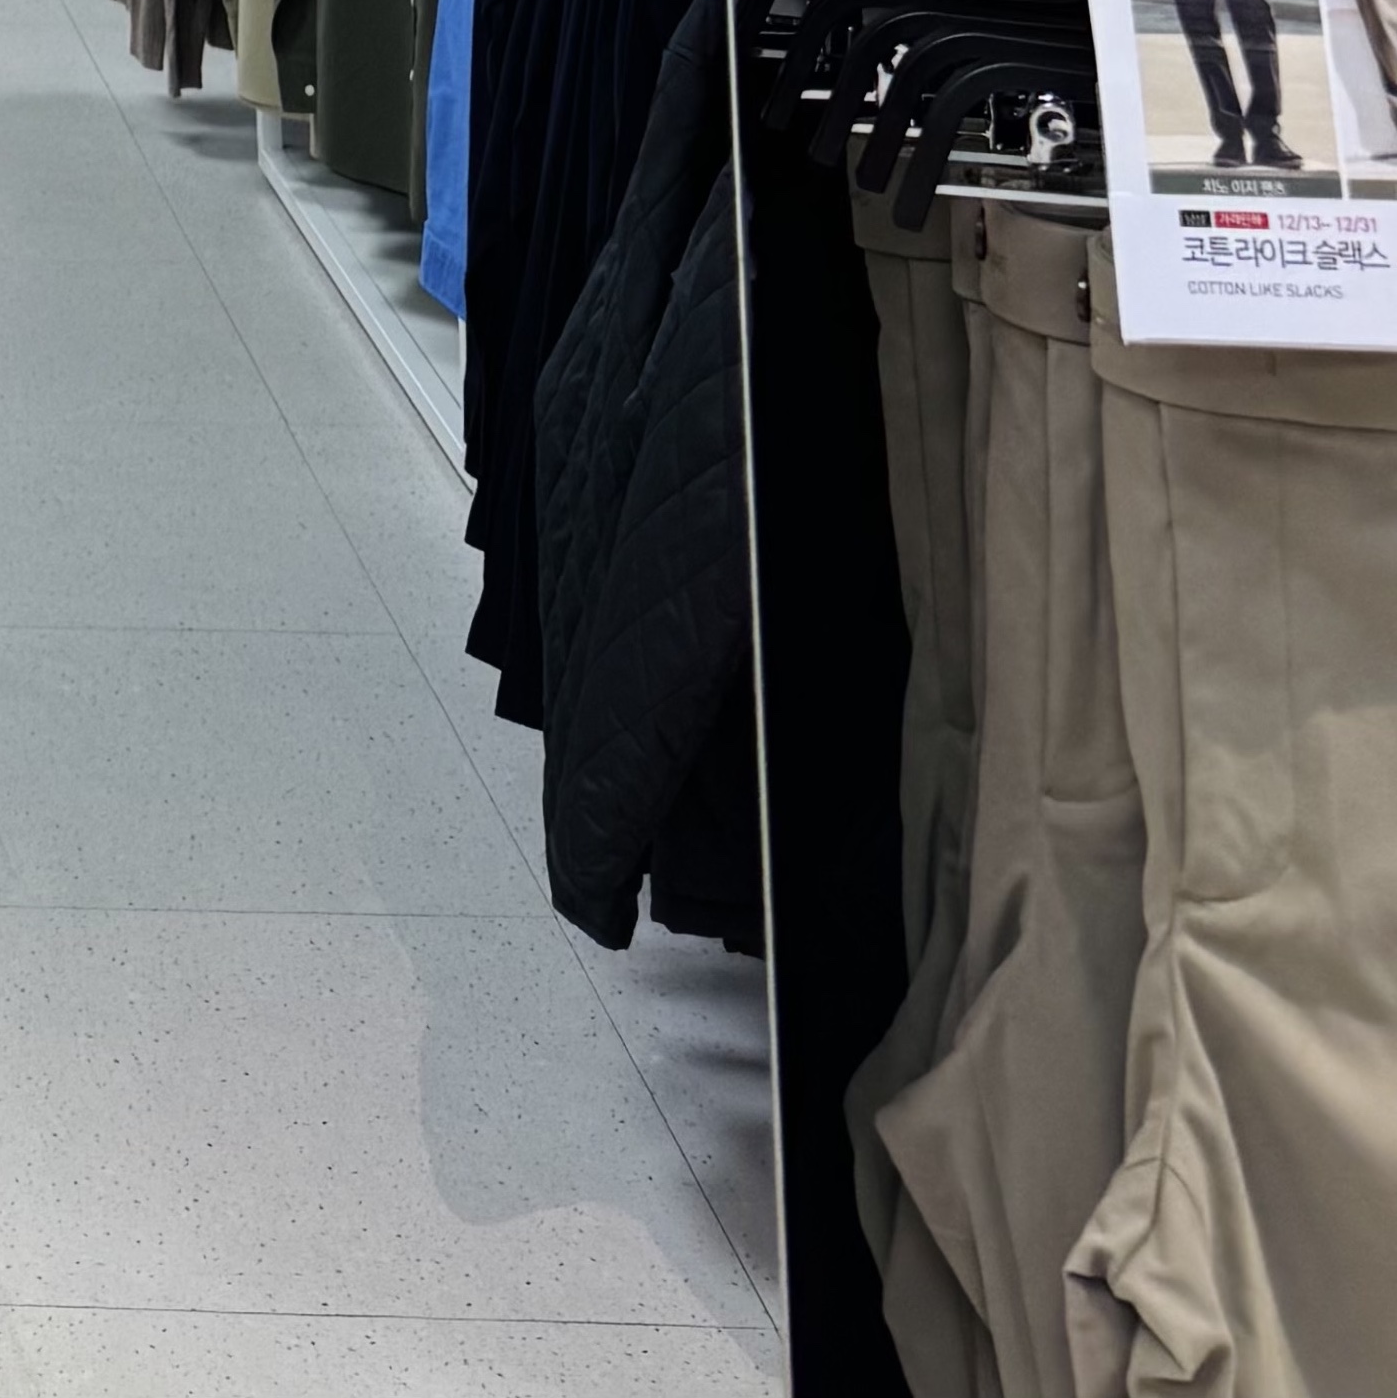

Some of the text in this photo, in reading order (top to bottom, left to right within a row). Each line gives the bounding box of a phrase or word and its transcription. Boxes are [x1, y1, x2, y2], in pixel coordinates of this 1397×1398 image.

[1231, 179, 1258, 195] 이지
[1334, 215, 1378, 233] 12/31
[1187, 280, 1344, 300] COTTON LIKE SLACKS
